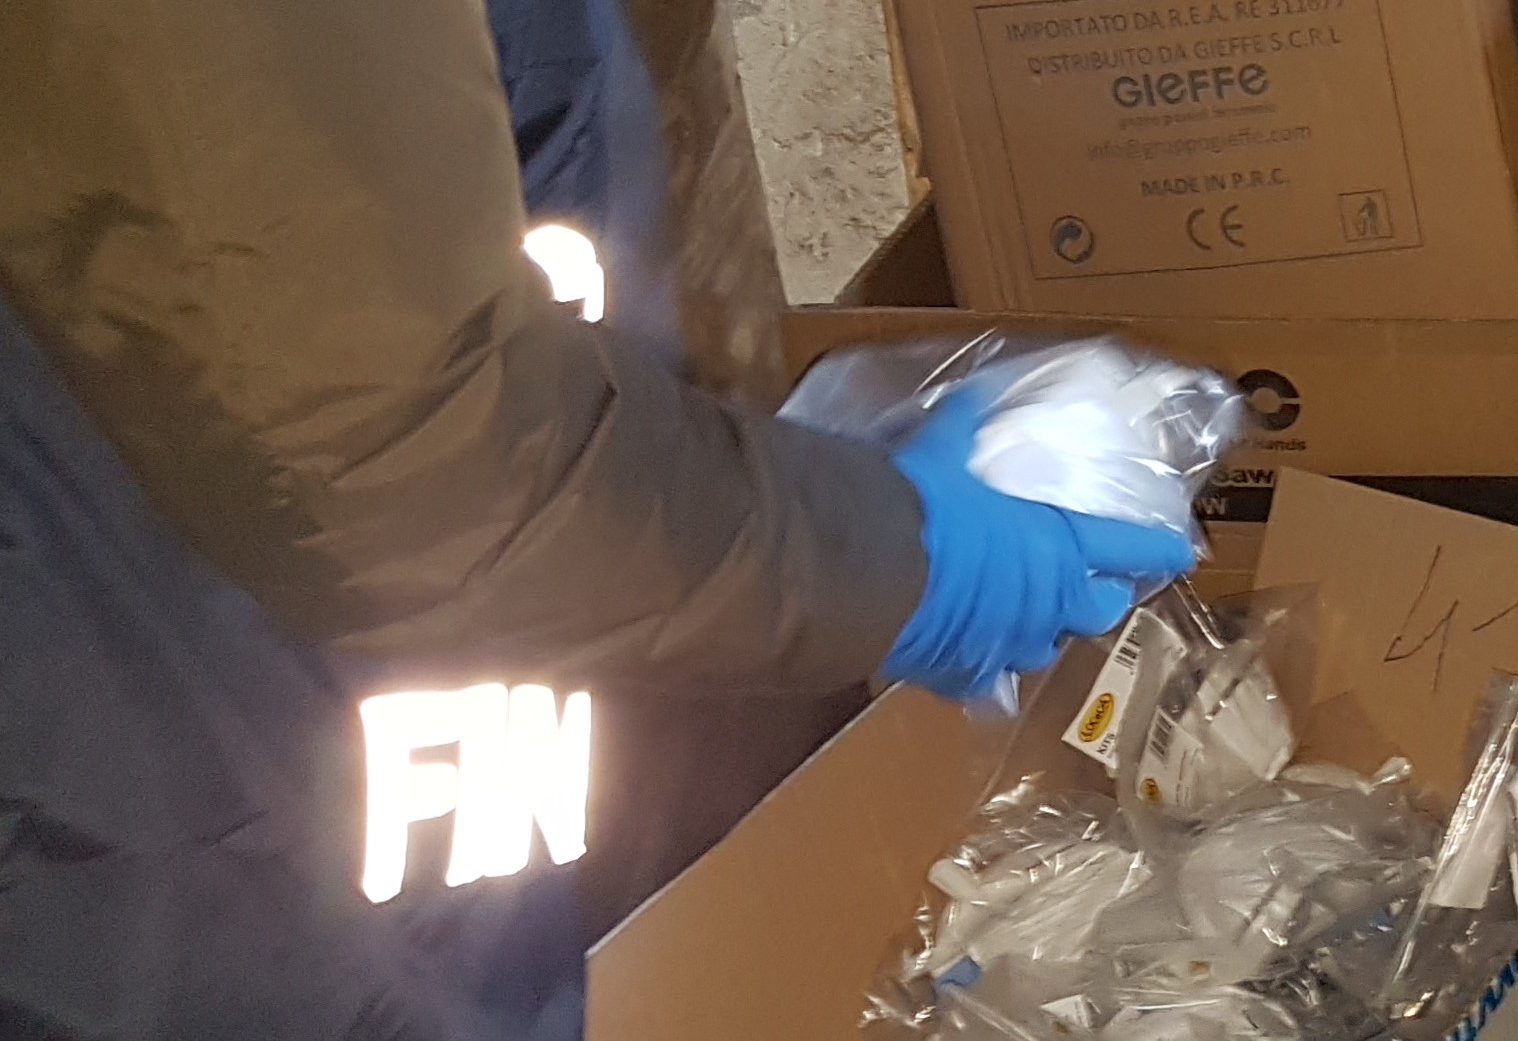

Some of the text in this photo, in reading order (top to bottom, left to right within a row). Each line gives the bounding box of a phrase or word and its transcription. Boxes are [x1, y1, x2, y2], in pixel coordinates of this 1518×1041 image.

[1005, 14, 1128, 41] IMPORTATO
[1134, 11, 1163, 30] DA
[1235, 0, 1262, 20] RE
[1028, 47, 1152, 74] DISTRIBUITO
[1158, 44, 1186, 63] DA
[1193, 35, 1265, 59] GIEFFE
[1140, 176, 1200, 196] MADE
[1203, 175, 1226, 191] IN
[1186, 204, 1245, 250] CE
